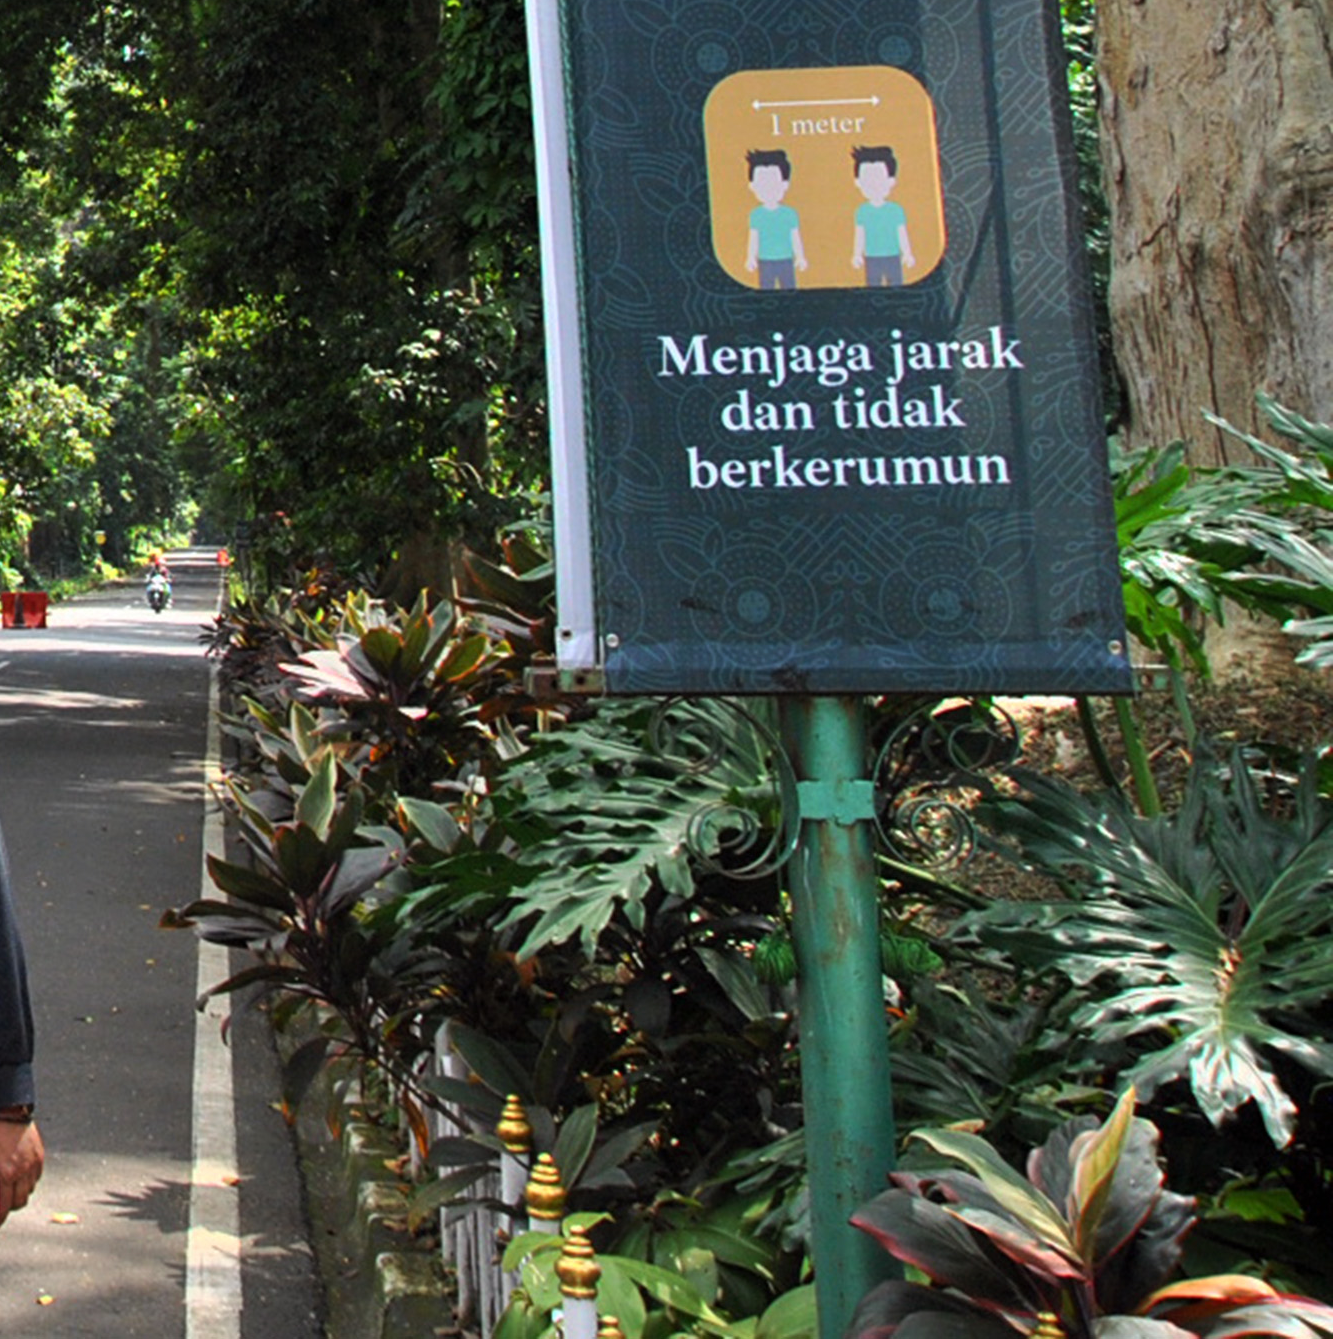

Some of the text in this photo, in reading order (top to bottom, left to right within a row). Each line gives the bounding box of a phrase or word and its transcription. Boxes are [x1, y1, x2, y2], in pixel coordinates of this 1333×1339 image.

[792, 115, 865, 136] meter
[656, 325, 1025, 388] Menjaga jarak
[720, 385, 967, 432] dan tidak
[686, 445, 1012, 489] berkerumun
